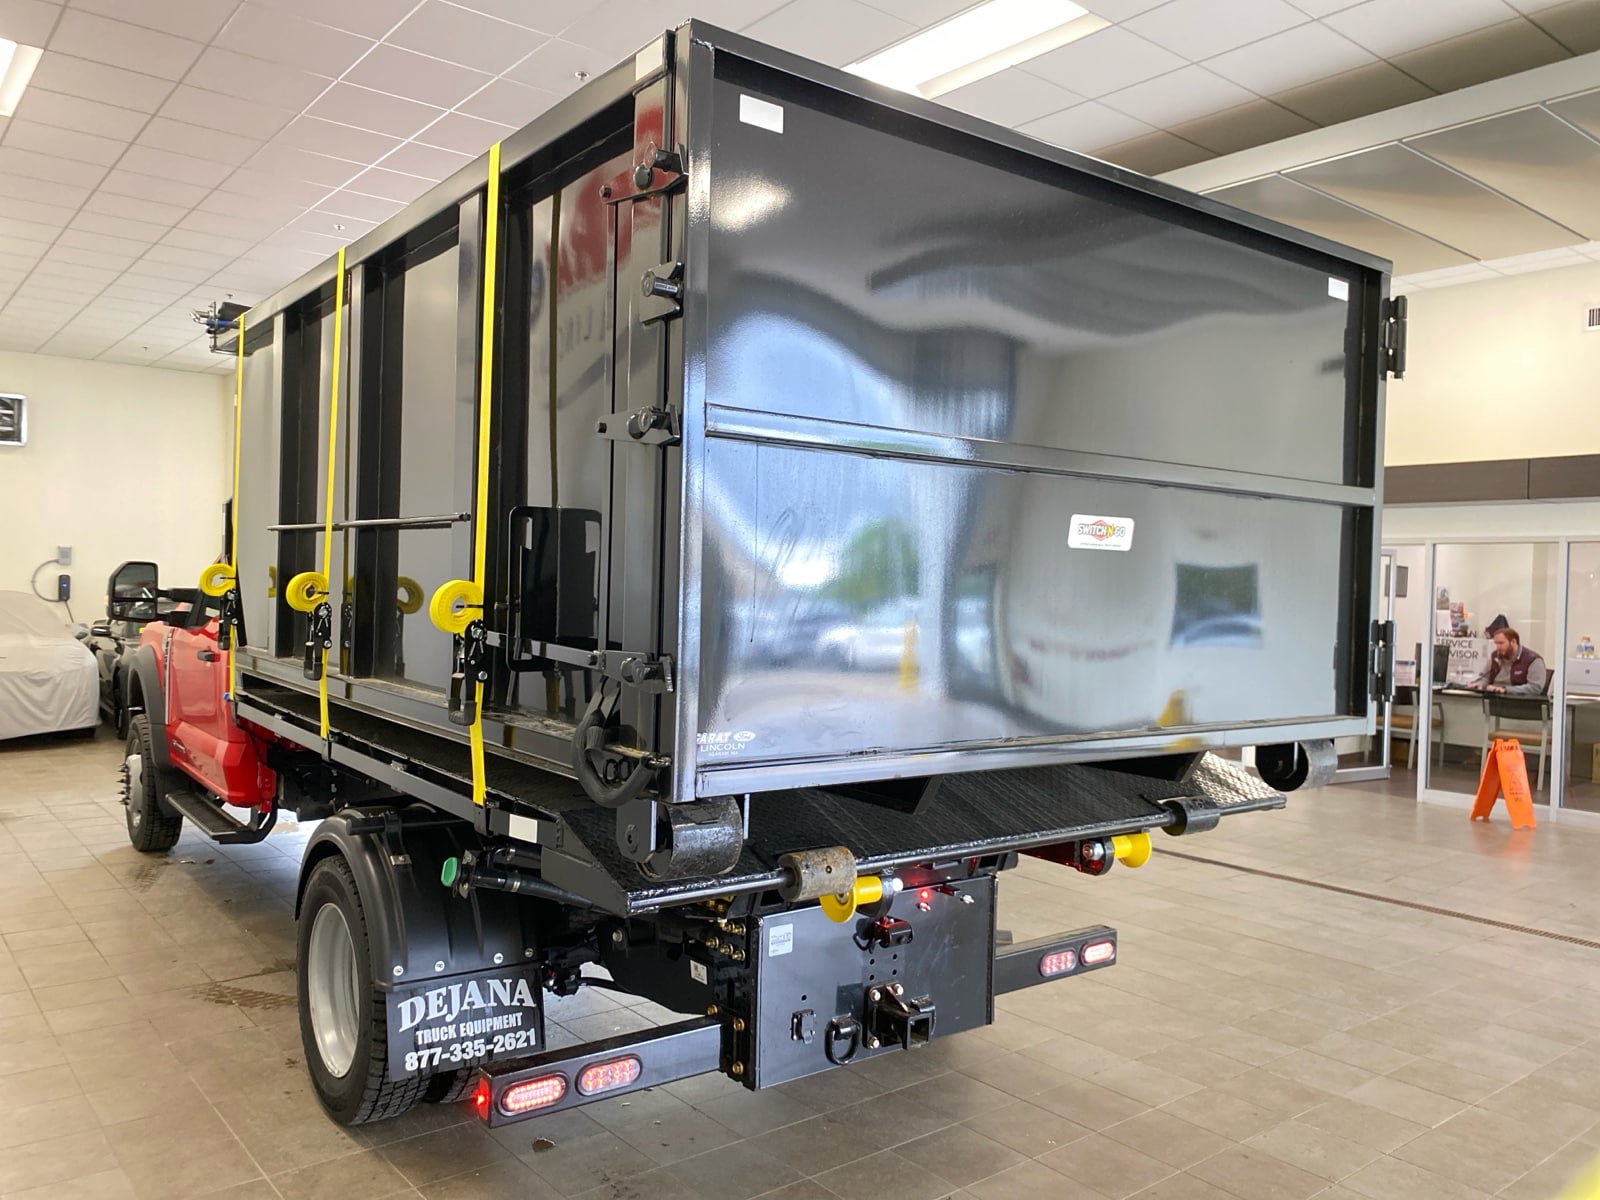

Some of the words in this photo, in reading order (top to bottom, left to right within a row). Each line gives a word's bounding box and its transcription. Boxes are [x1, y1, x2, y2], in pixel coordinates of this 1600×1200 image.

[1435, 649, 1479, 659] AVISOR
[700, 742, 745, 752] LINCOLN
[397, 978, 536, 1032] DEJANA
[416, 1024, 457, 1045] TRUCK
[459, 1012, 523, 1038] EQUIPMENT
[404, 1028, 536, 1071] 877-335-2621
